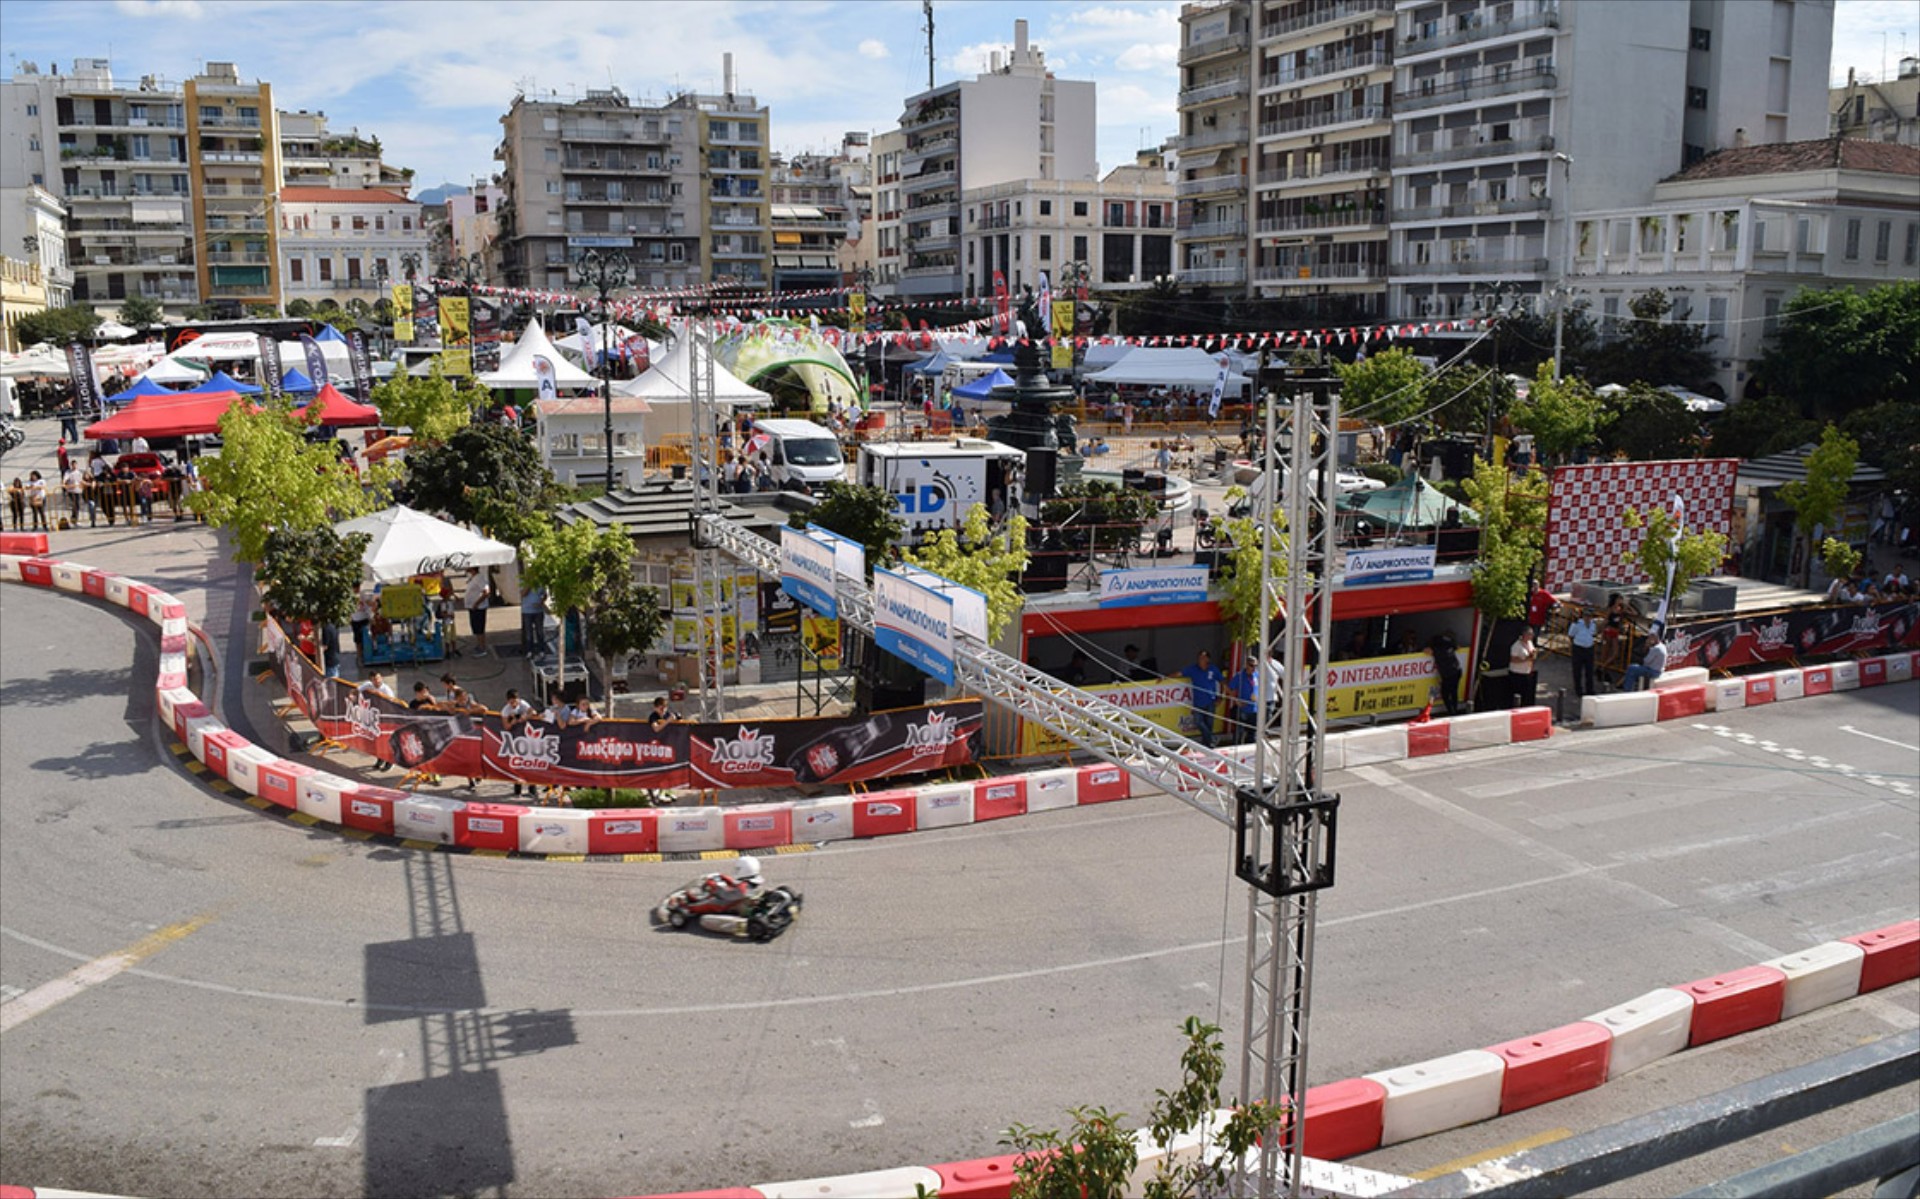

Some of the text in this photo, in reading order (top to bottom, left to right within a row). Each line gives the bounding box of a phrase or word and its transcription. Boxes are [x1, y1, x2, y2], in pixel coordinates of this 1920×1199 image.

[1126, 577, 1204, 591] ΑΝΔΡΙΚΟΠΟΥΛΟΣ
[1341, 660, 1441, 684] INTERAMERICA
[578, 737, 672, 761] λουξάρω γεύση
[510, 756, 548, 769] Cola
[722, 760, 761, 772] Cola
